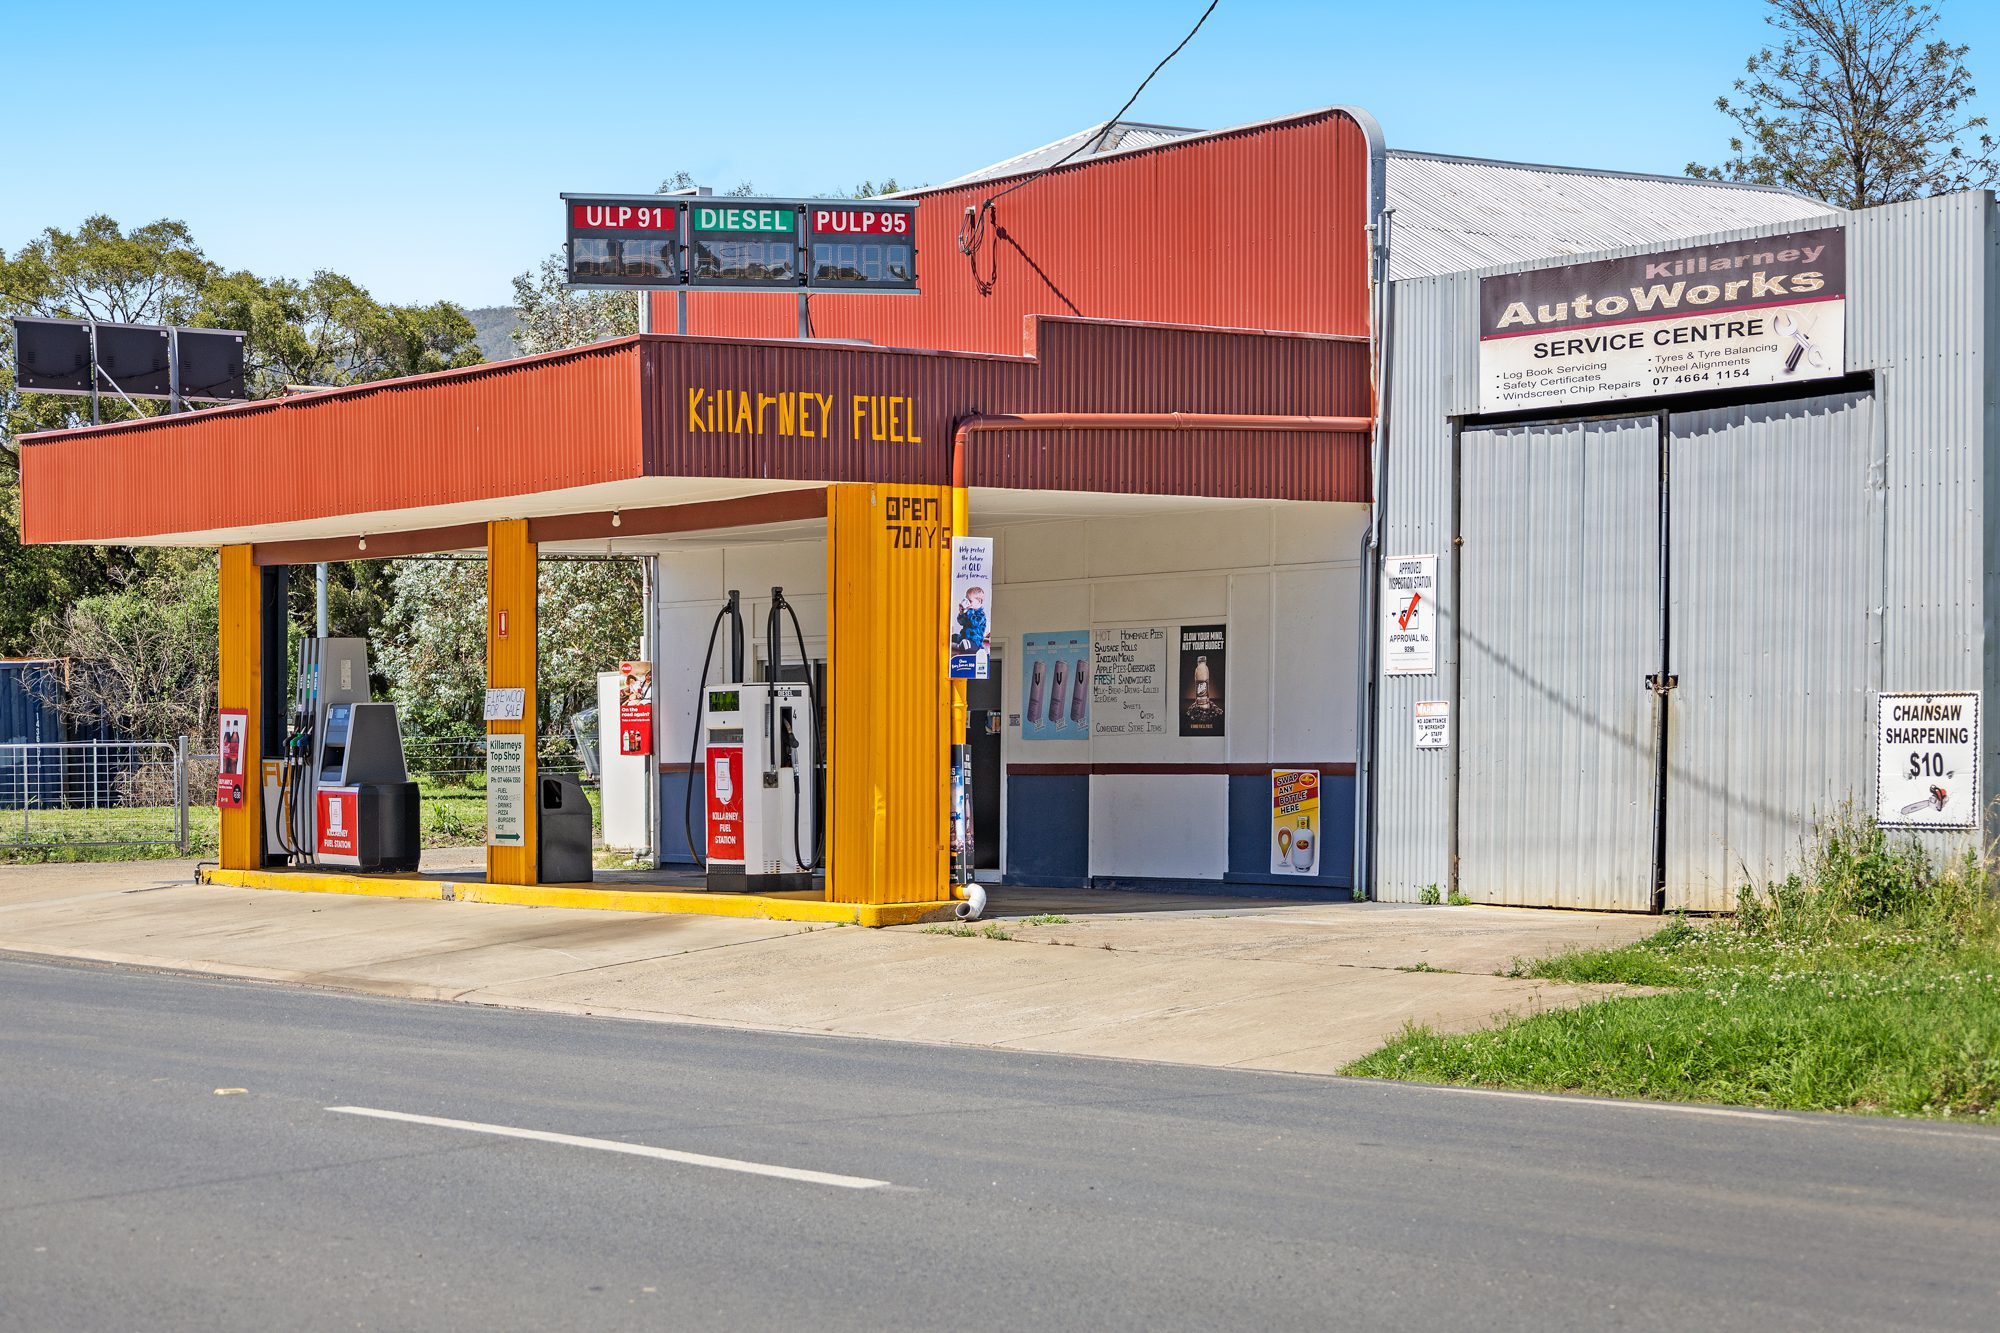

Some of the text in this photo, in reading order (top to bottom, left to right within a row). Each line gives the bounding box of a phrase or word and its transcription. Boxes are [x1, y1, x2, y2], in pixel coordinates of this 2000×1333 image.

[586, 206, 662, 228] ULP 91
[700, 208, 787, 230] DIESEL
[817, 210, 906, 232] PULP 95
[1645, 246, 1825, 280] Killarney
[1496, 271, 1825, 328] AutoWorks
[1534, 318, 1764, 358] SERVICE CENTRE
[1655, 343, 1778, 364] Tyres & Tyre Balancing
[1503, 361, 1607, 380] Log Book Servicing
[1655, 358, 1750, 374] Wheel Alignments
[1503, 372, 1600, 392] Safety Certificates
[1653, 368, 1750, 386] 07 4664 1154
[1503, 380, 1640, 400] Windscreen Chip Repairs
[854, 395, 922, 442] FUEL
[1399, 562, 1422, 574] APPROVED
[1389, 576, 1432, 590] INSPECTION STATION
[1390, 634, 1419, 642] APPROVAL
[793, 710, 797, 720] 4
[1893, 705, 1962, 721] CHAINSAW
[1886, 728, 1968, 744] SHARPENING
[490, 740, 521, 751] Killarneys
[491, 751, 520, 762] Top Shop
[1910, 751, 1944, 779] $10
[1277, 773, 1299, 786] SWAP
[1278, 785, 1293, 795] ANY
[1279, 790, 1307, 805] BOTTLE
[712, 812, 738, 820] KILLARNEY
[1280, 803, 1300, 814] HERE
[720, 823, 731, 832] FUEL
[324, 839, 351, 848] FUEL STATION
[715, 835, 736, 844] STATION
